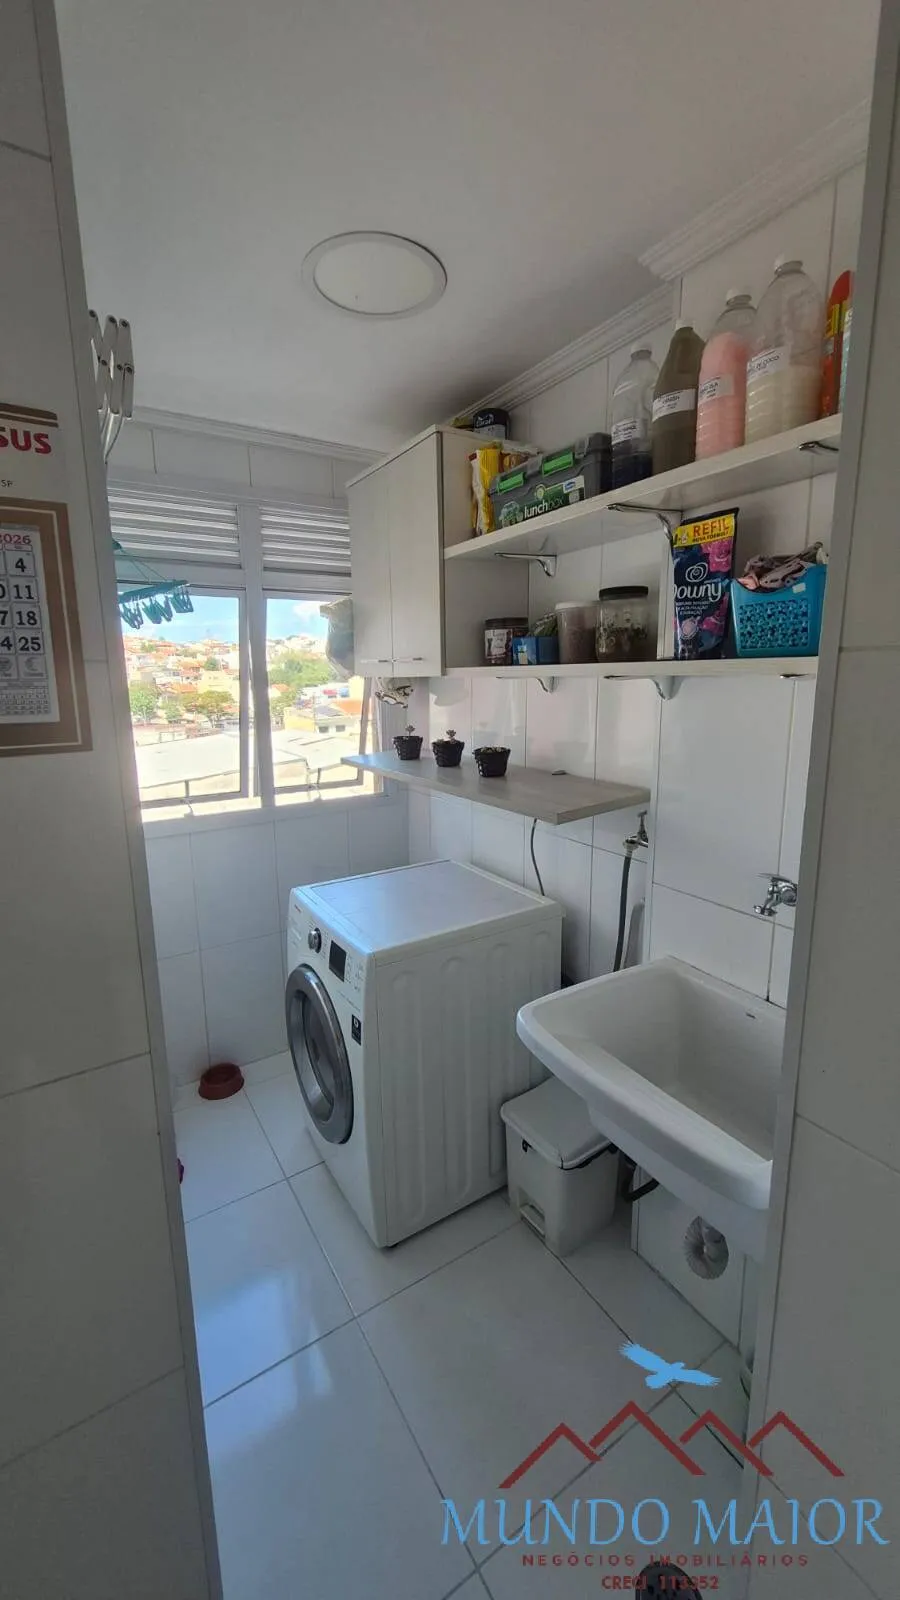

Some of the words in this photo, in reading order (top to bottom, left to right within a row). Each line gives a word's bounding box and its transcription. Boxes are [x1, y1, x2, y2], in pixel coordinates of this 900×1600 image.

[692, 518, 730, 537] REFIL
[0, 533, 31, 545] 026
[15, 558, 26, 573] 4
[13, 584, 34, 600] 11
[16, 610, 37, 626] 18
[18, 636, 41, 652] 25
